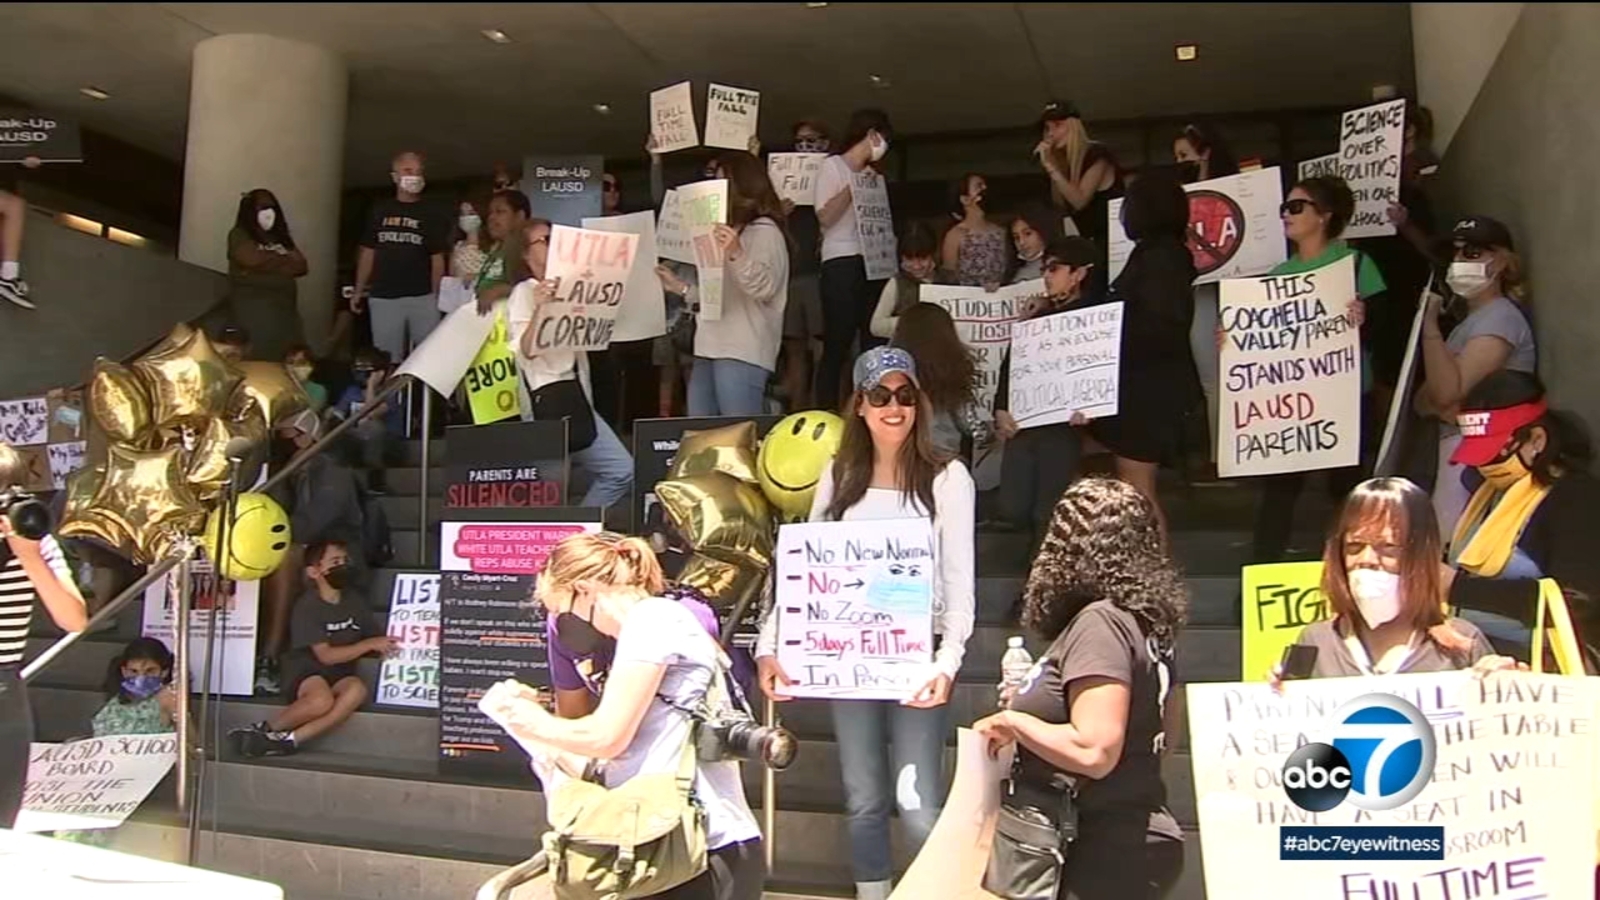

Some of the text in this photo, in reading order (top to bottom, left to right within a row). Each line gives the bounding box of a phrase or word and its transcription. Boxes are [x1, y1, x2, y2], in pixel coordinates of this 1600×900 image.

[1343, 105, 1403, 140] SCIENCE
[1344, 135, 1388, 160] OVER
[536, 167, 591, 180] Break-Up
[1340, 155, 1398, 181] POLITICS
[542, 181, 585, 192] LAUSD
[557, 232, 633, 270] UTLA
[553, 276, 624, 306] LAUSD
[1261, 273, 1316, 300] THIS
[1219, 298, 1328, 333] COACHELLA
[1014, 318, 1052, 339] UTLA
[1231, 326, 1301, 350] VALLEY
[1226, 346, 1355, 392] STANDS WITH
[1235, 421, 1339, 464] PARENTS
[469, 467, 538, 482] PARENTS ARE
[447, 481, 561, 508] SILENCED
[463, 530, 486, 541] UTLA
[488, 530, 541, 541] PRESIDENT
[457, 543, 487, 554] WHITE
[489, 543, 513, 554] UTLA
[805, 535, 935, 563] No New Normal
[500, 558, 534, 568] ABUSE
[396, 579, 440, 604] LIST
[808, 571, 841, 595] No
[391, 608, 410, 621] TO
[807, 600, 894, 624] No Zoom
[1256, 583, 1326, 632] FIG
[388, 624, 440, 644] LIST
[860, 630, 889, 655] Full
[890, 629, 927, 655] Time
[802, 664, 840, 686] In
[381, 684, 400, 698] TO
[403, 686, 440, 701] SCIE
[1478, 677, 1575, 705] HAVE
[1222, 732, 1243, 758] A
[1254, 728, 1310, 756] SEA
[1493, 711, 1590, 738] TABLE
[46, 760, 114, 777] BOARD
[1489, 751, 1568, 773] WILL
[1393, 794, 1467, 822] SEAT
[1489, 786, 1523, 812] IN
[1422, 856, 1546, 900] TIME
